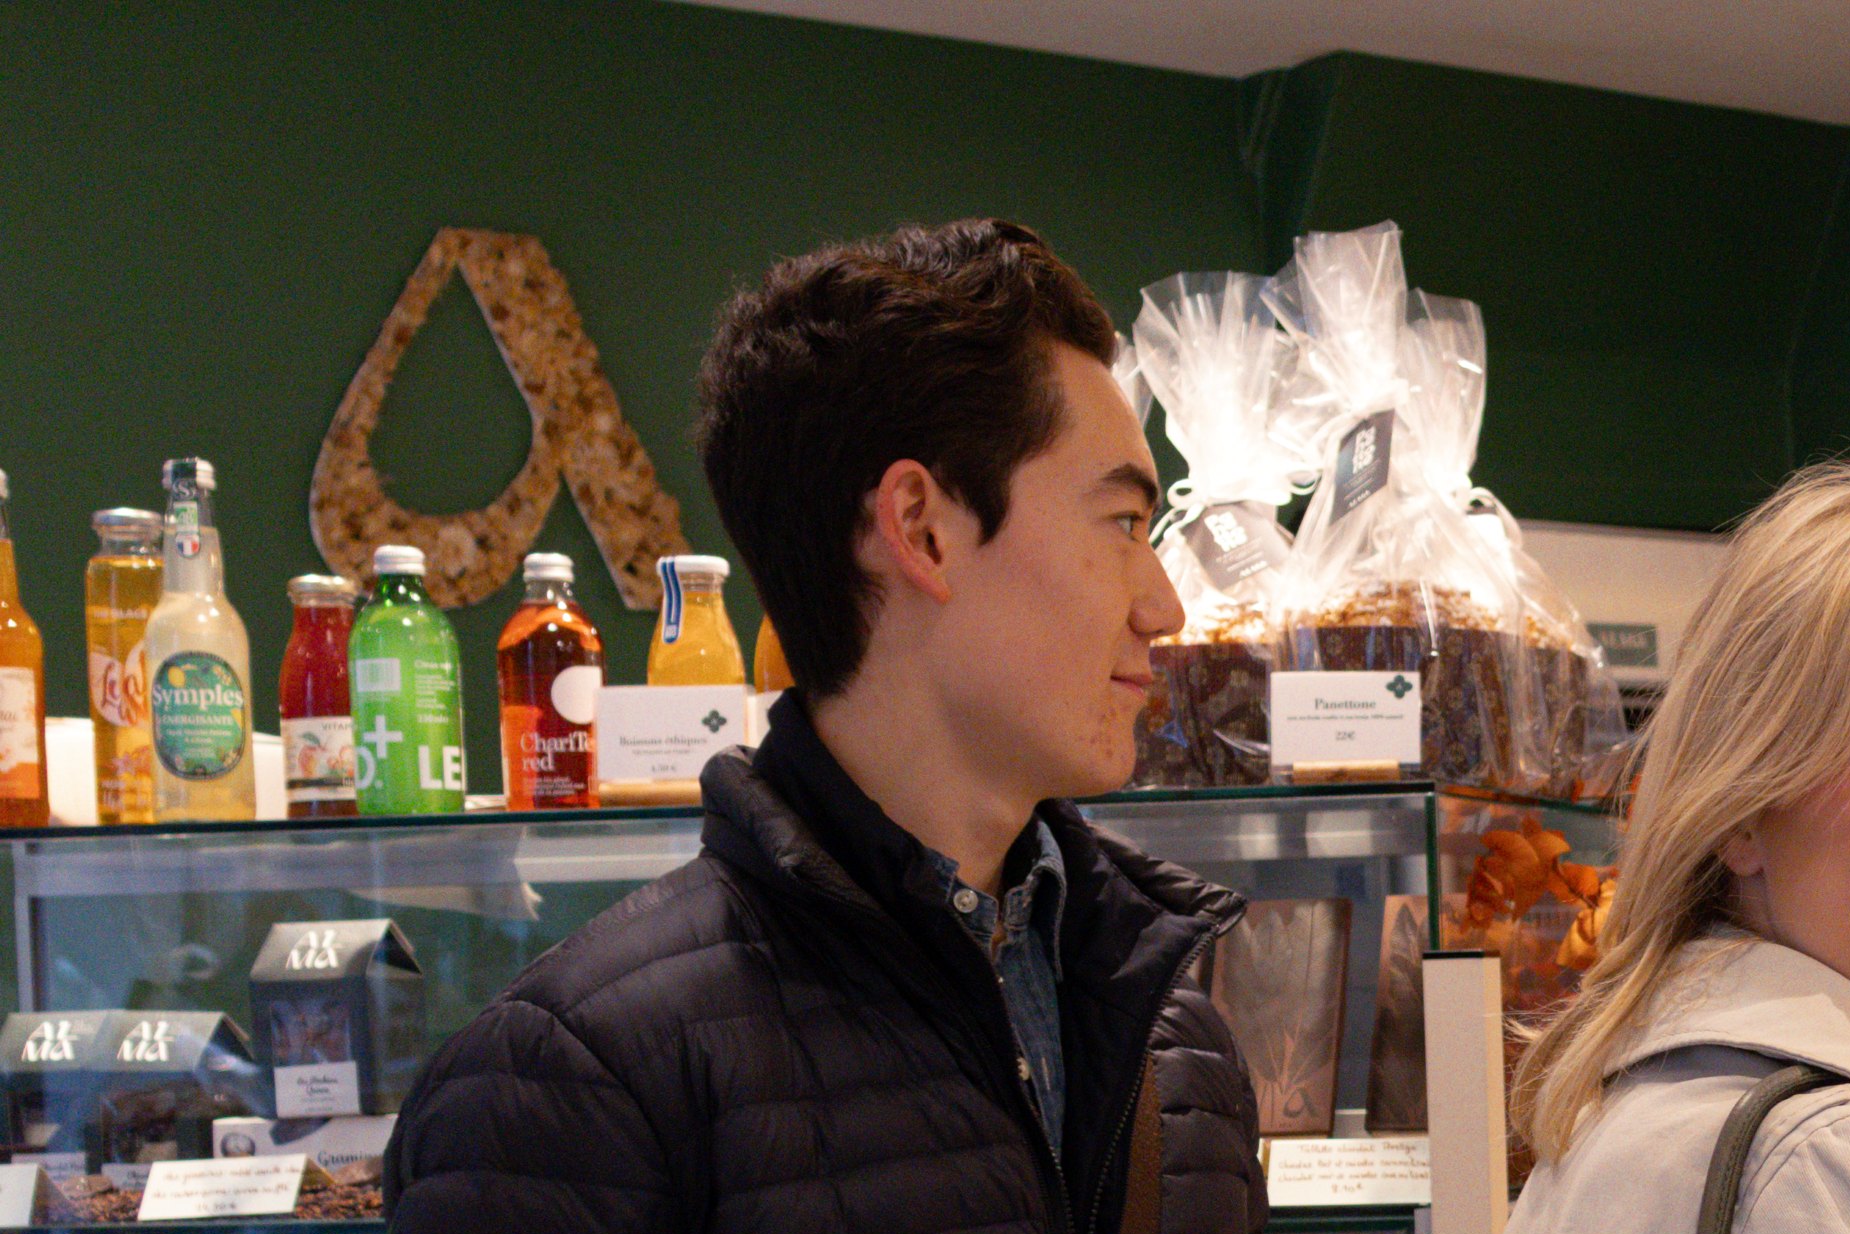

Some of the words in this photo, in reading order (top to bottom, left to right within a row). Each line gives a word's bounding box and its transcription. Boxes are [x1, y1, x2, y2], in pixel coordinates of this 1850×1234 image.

[153, 684, 243, 711] Symples
[1314, 698, 1376, 710] Panettone
[523, 751, 554, 771] red
